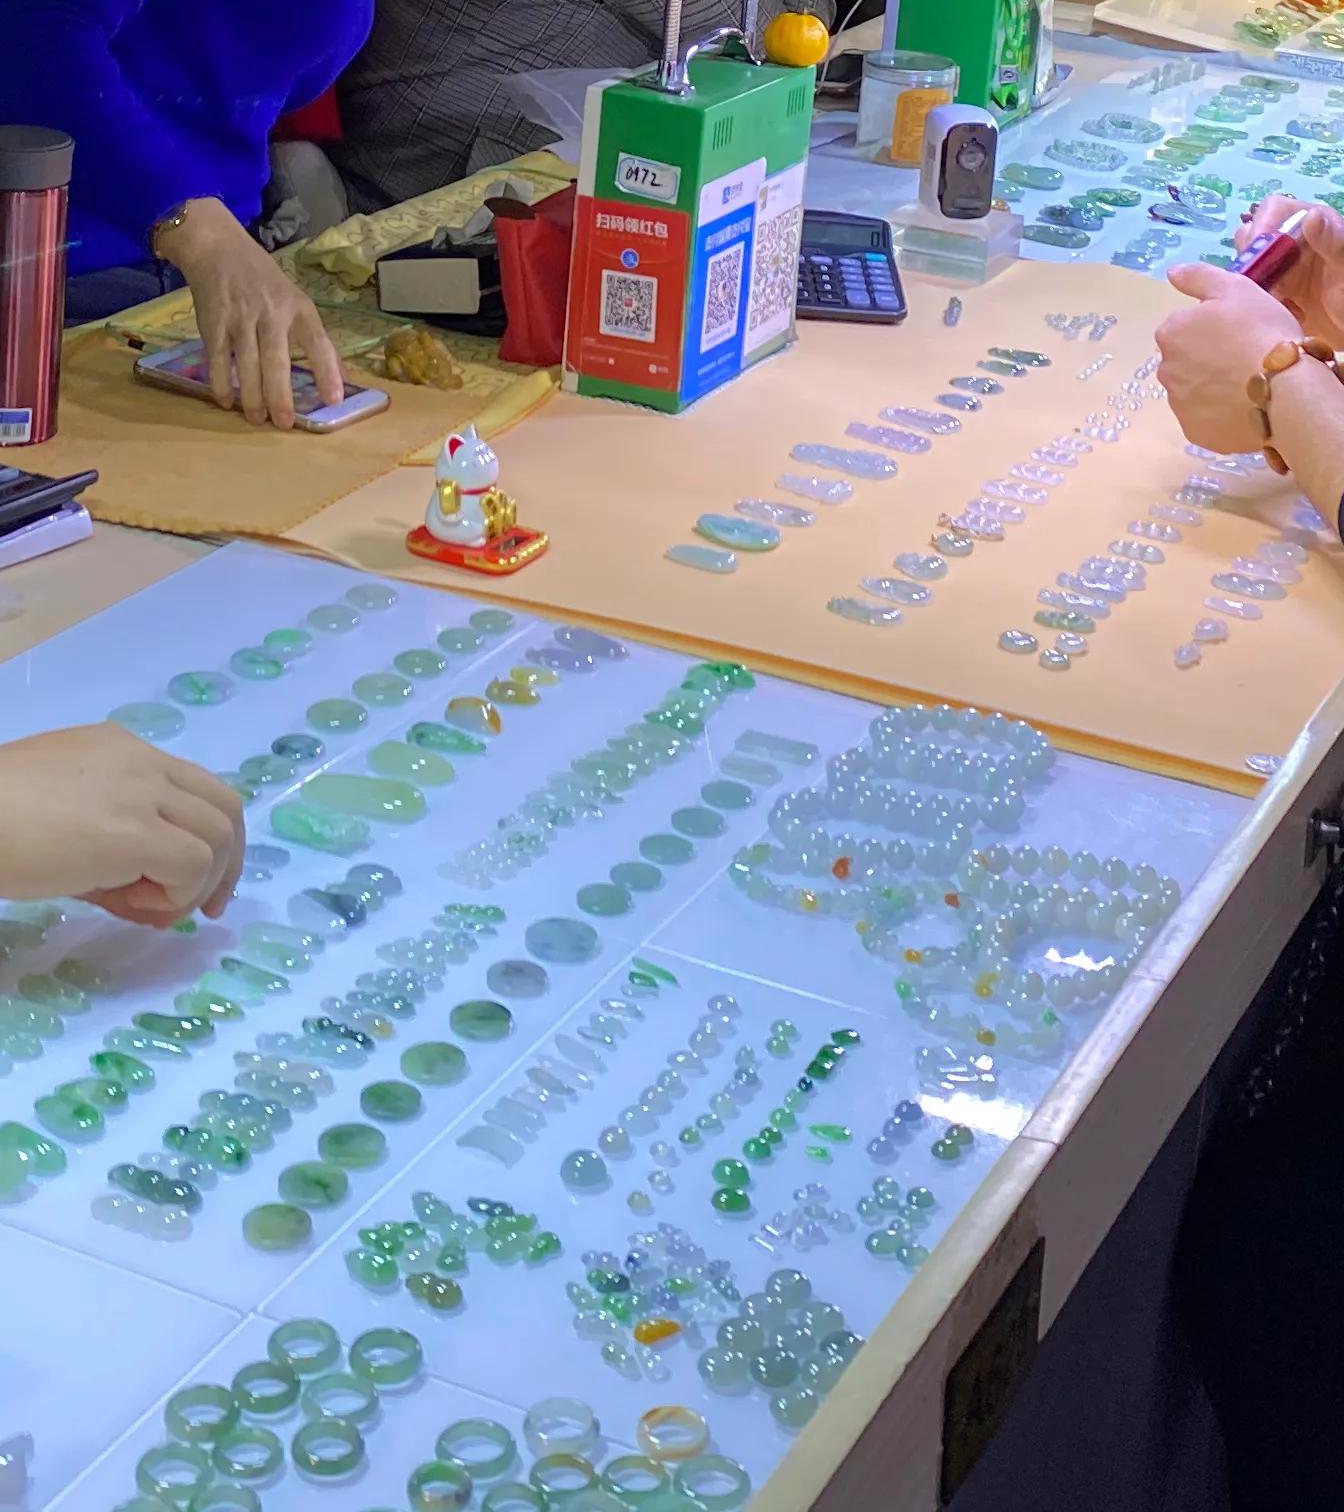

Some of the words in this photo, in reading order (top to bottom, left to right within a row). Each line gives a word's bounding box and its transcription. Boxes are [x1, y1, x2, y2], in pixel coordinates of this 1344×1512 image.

[596, 212, 668, 240] 扫码领红包
[870, 231, 881, 248] 0
